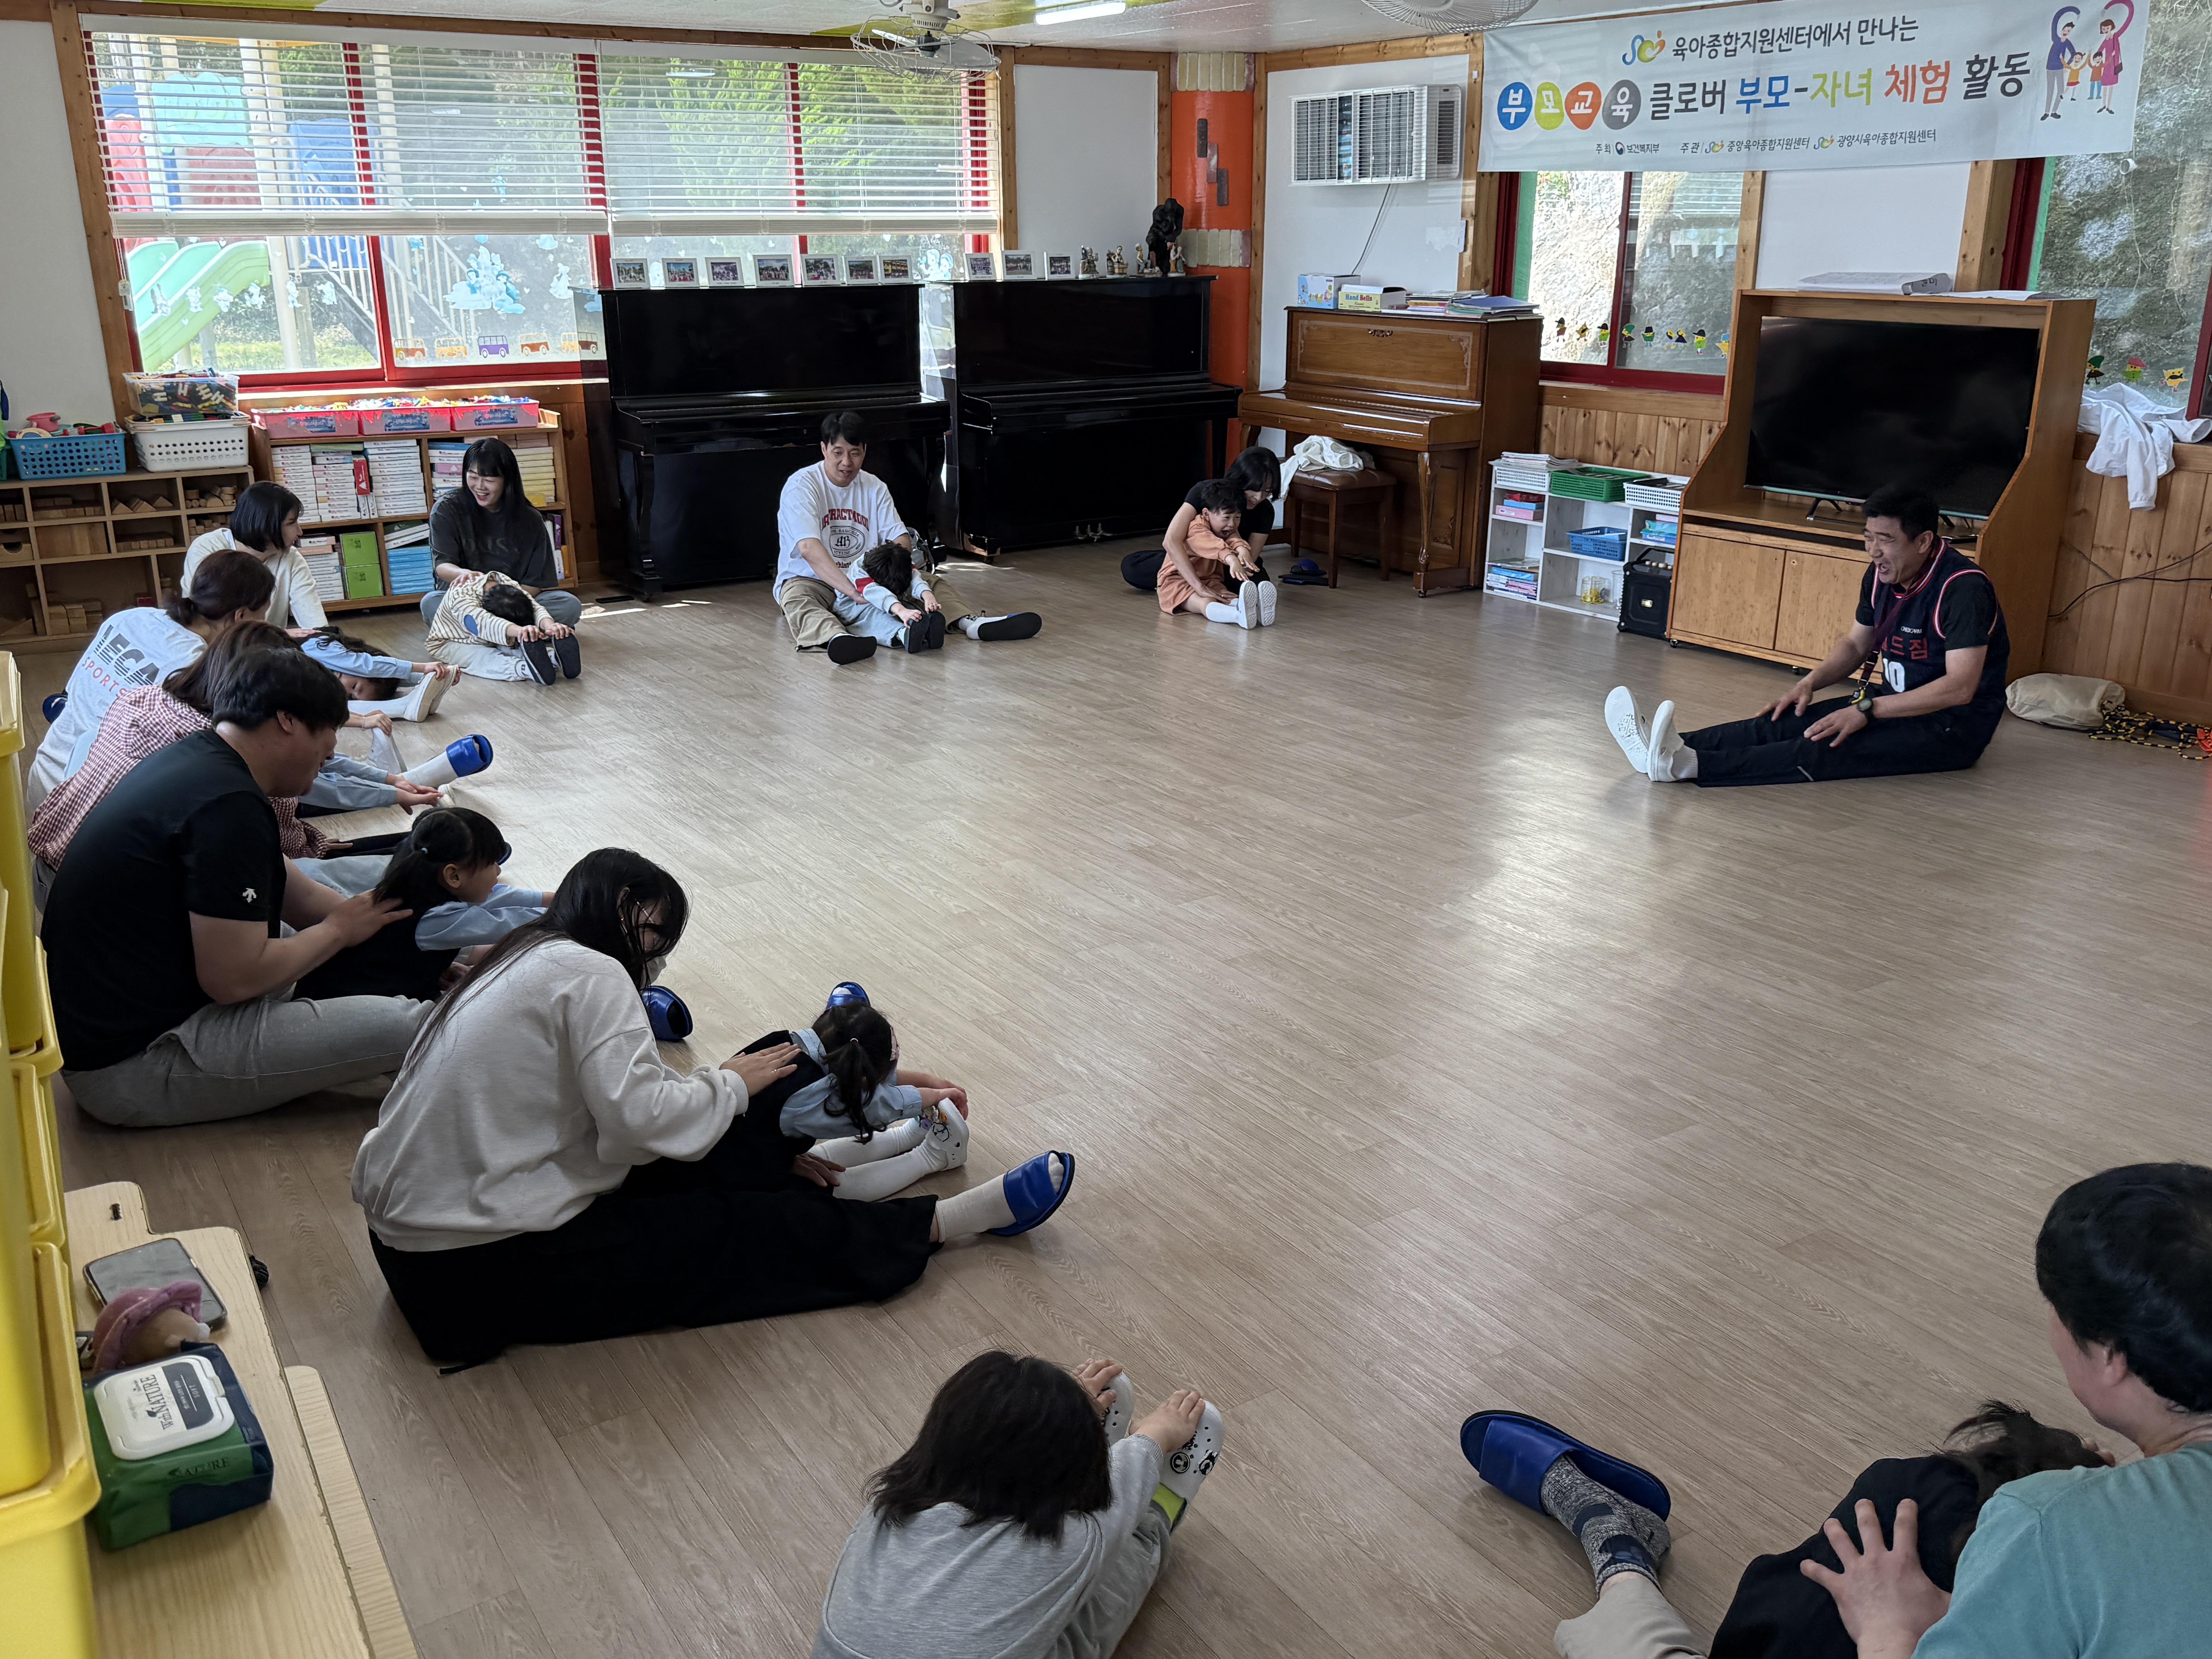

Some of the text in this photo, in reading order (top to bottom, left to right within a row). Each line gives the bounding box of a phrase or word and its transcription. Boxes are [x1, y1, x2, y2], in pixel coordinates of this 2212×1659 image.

[1672, 15, 1919, 61] 육아종합지원센터에서 만나는
[1649, 79, 1726, 120] 클로버
[1884, 60, 1950, 104] 체험
[1963, 52, 2030, 100] 활동
[1626, 143, 1660, 154] 보건복지부
[1727, 137, 1810, 152] 중앙육아종합지원센터
[1837, 129, 1936, 148] 광양시육아종합지원센터
[82, 656, 128, 700] SPORTS
[189, 1385, 200, 1398] SOFT
